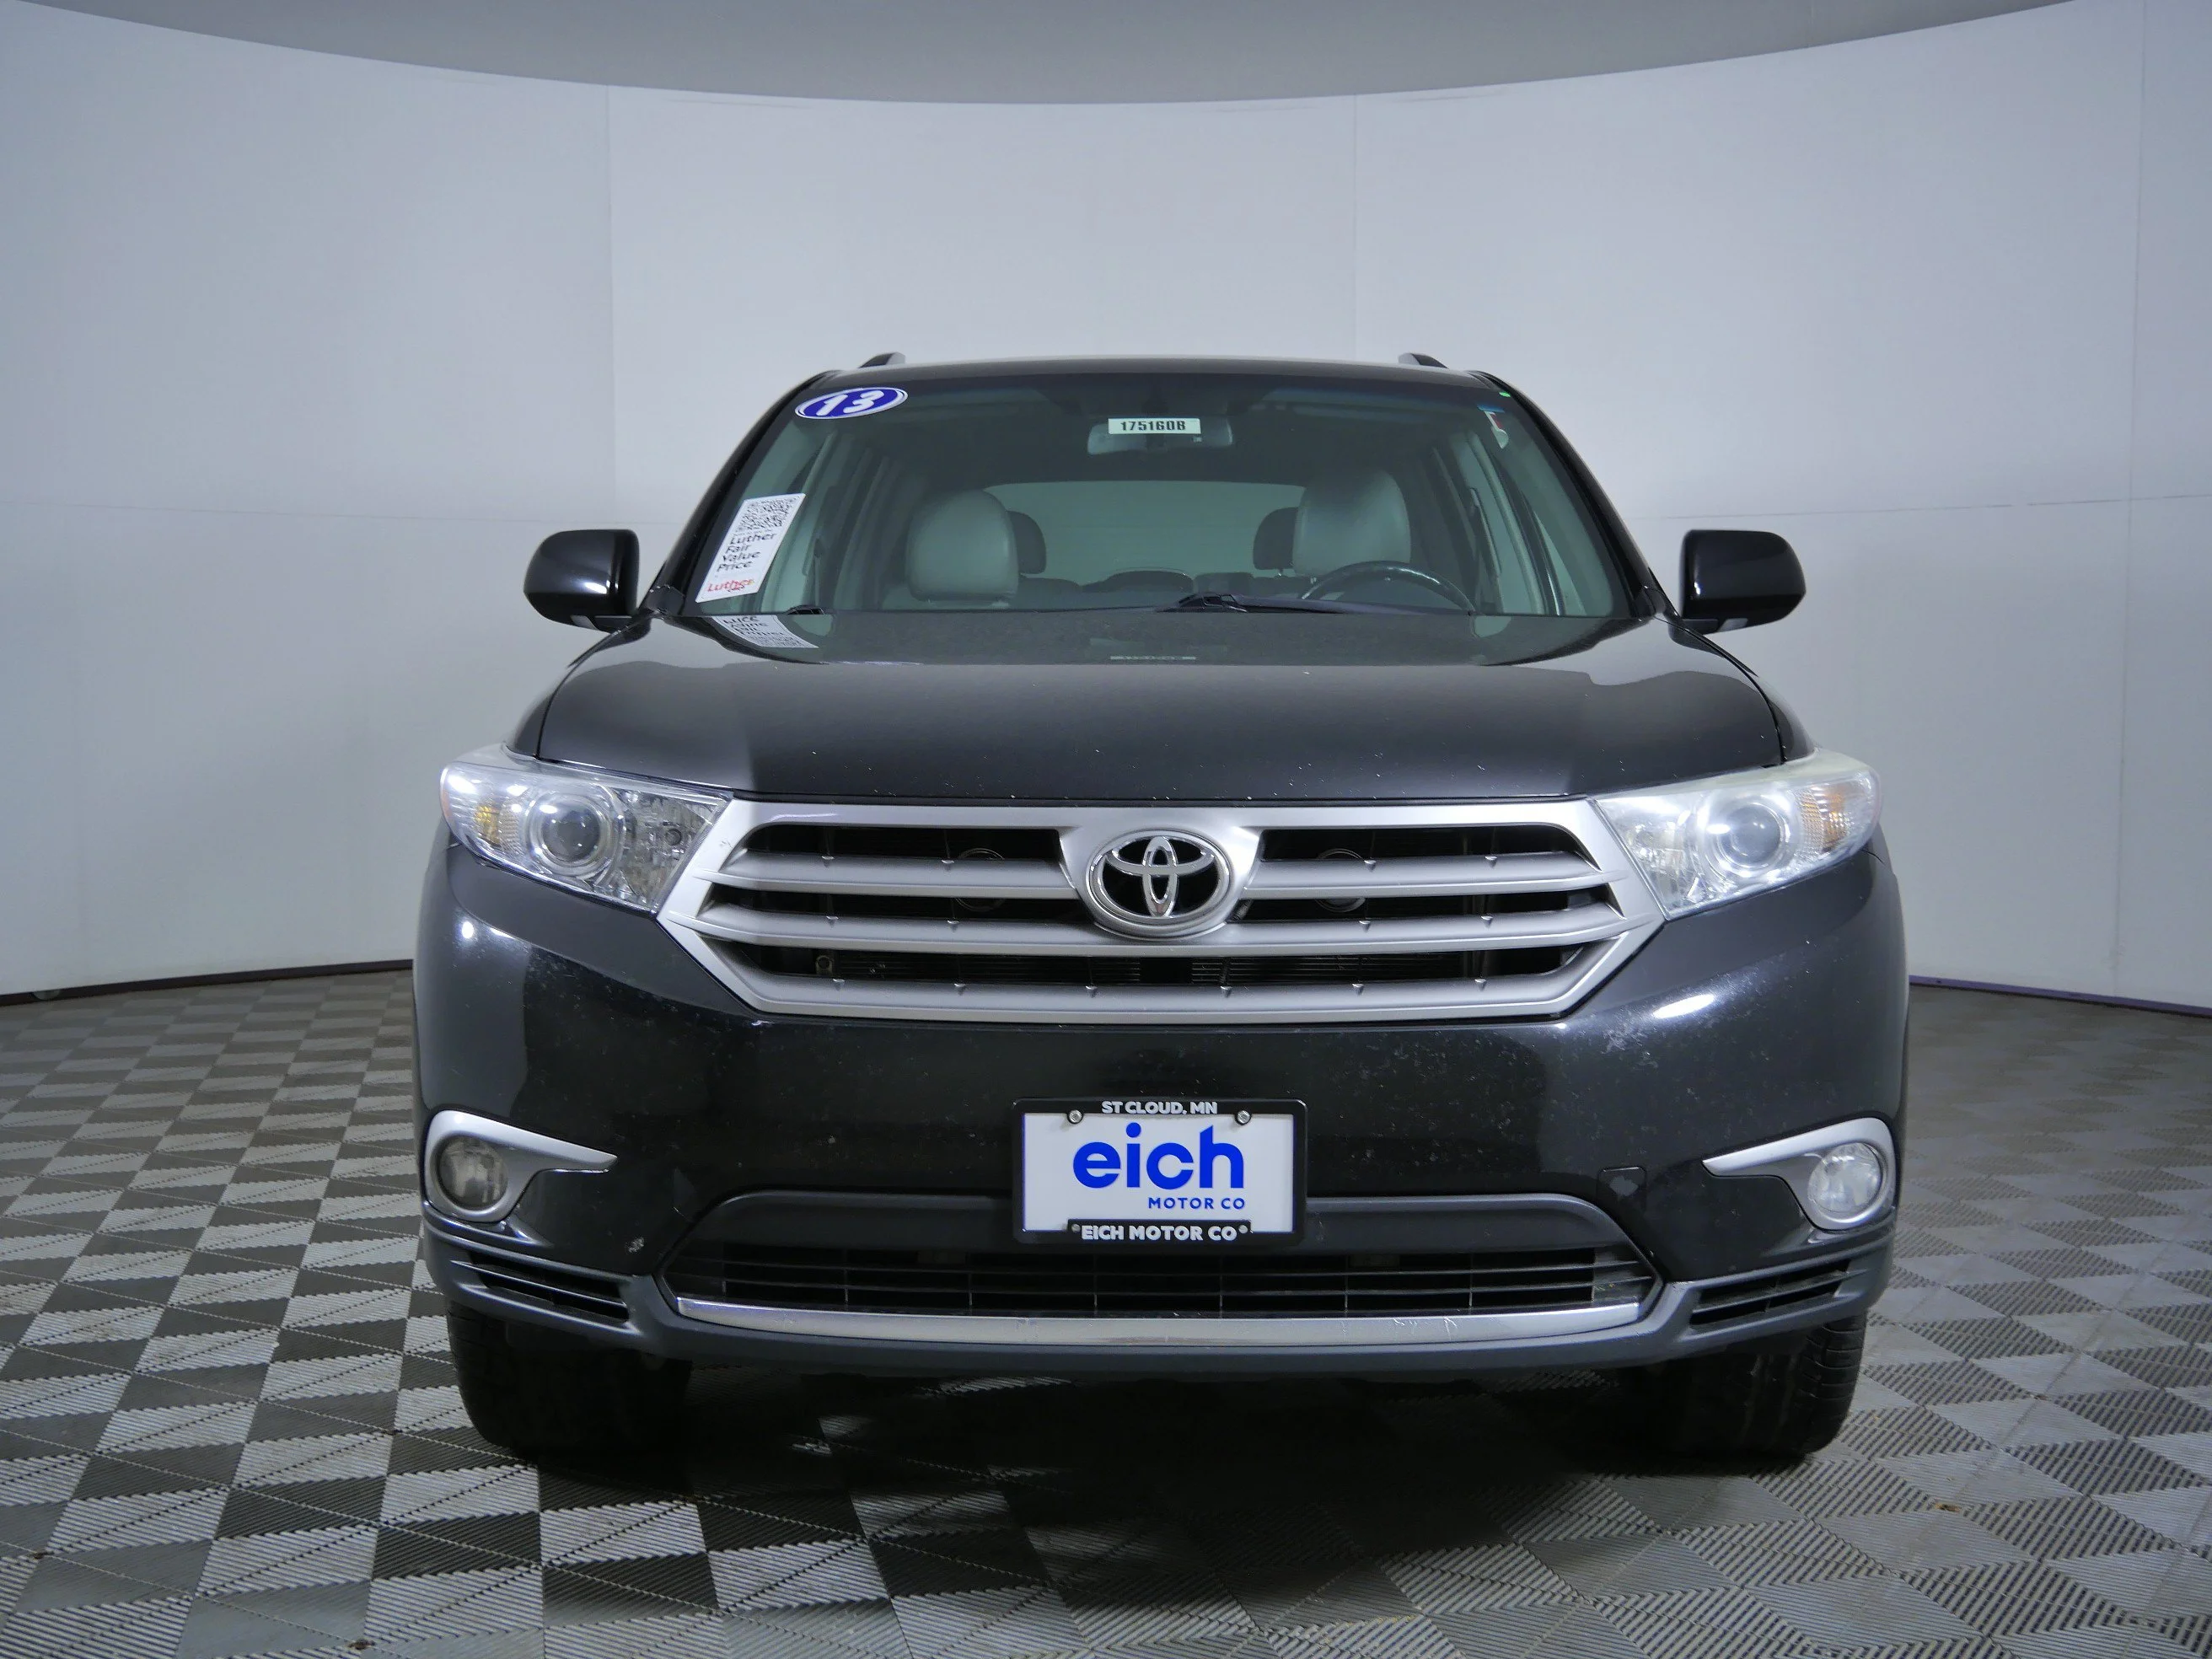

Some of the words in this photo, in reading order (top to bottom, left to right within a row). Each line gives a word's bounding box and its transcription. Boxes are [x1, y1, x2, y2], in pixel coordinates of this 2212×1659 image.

[815, 390, 885, 416] 13
[730, 533, 776, 544] Luther
[725, 545, 750, 553] Fair
[722, 551, 761, 561] Value
[717, 561, 753, 572] Price
[1101, 1100, 1122, 1114] ST
[1125, 1100, 1188, 1115] CLOUD,
[1190, 1100, 1218, 1114] MN
[1072, 1122, 1244, 1189] eich
[1147, 1197, 1214, 1210] MOTOR
[1220, 1197, 1245, 1210] CO
[1081, 1224, 1125, 1240] EICH
[1129, 1225, 1204, 1242] MOTOR
[1207, 1225, 1238, 1242] CO
